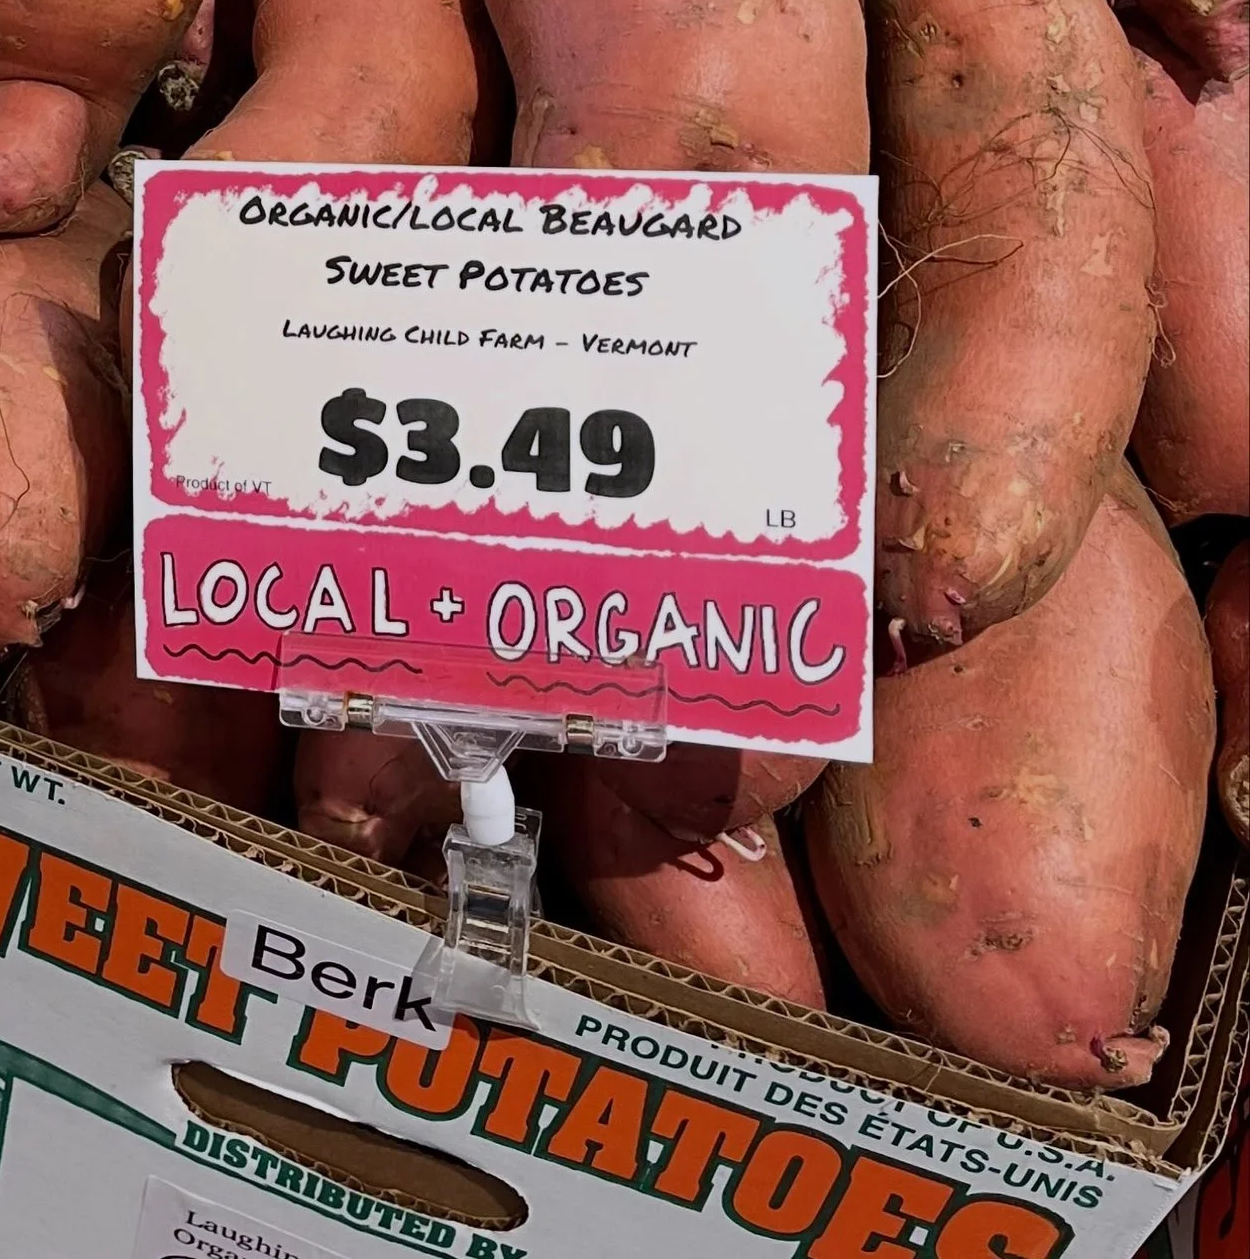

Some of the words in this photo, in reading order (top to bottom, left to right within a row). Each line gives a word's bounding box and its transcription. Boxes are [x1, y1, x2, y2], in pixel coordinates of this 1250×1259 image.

[238, 194, 524, 234] ORGANIC/LOCAL
[541, 204, 743, 240] BEAUGARD
[326, 254, 449, 291] SWEET
[459, 259, 650, 299] POTATOES
[282, 318, 397, 344] LAUGHING
[404, 325, 470, 348] CHILD
[479, 329, 546, 352] FARM
[581, 333, 698, 359] VERMONT
[318, 386, 656, 499] $3.49
[175, 475, 230, 493] Product
[234, 480, 248, 494] of
[251, 480, 272, 494] VT
[765, 508, 797, 529] LB
[159, 553, 410, 638] LOCAL
[485, 582, 848, 687] ORGANIC
[9, 765, 67, 805] WT.
[251, 924, 437, 1033] Berk
[575, 1014, 757, 1094] PRODUIT
[762, 1080, 848, 1127] DES
[857, 1111, 1106, 1211] ÉTATS-UNIS
[182, 1119, 456, 1249] DISTRIBUTED
